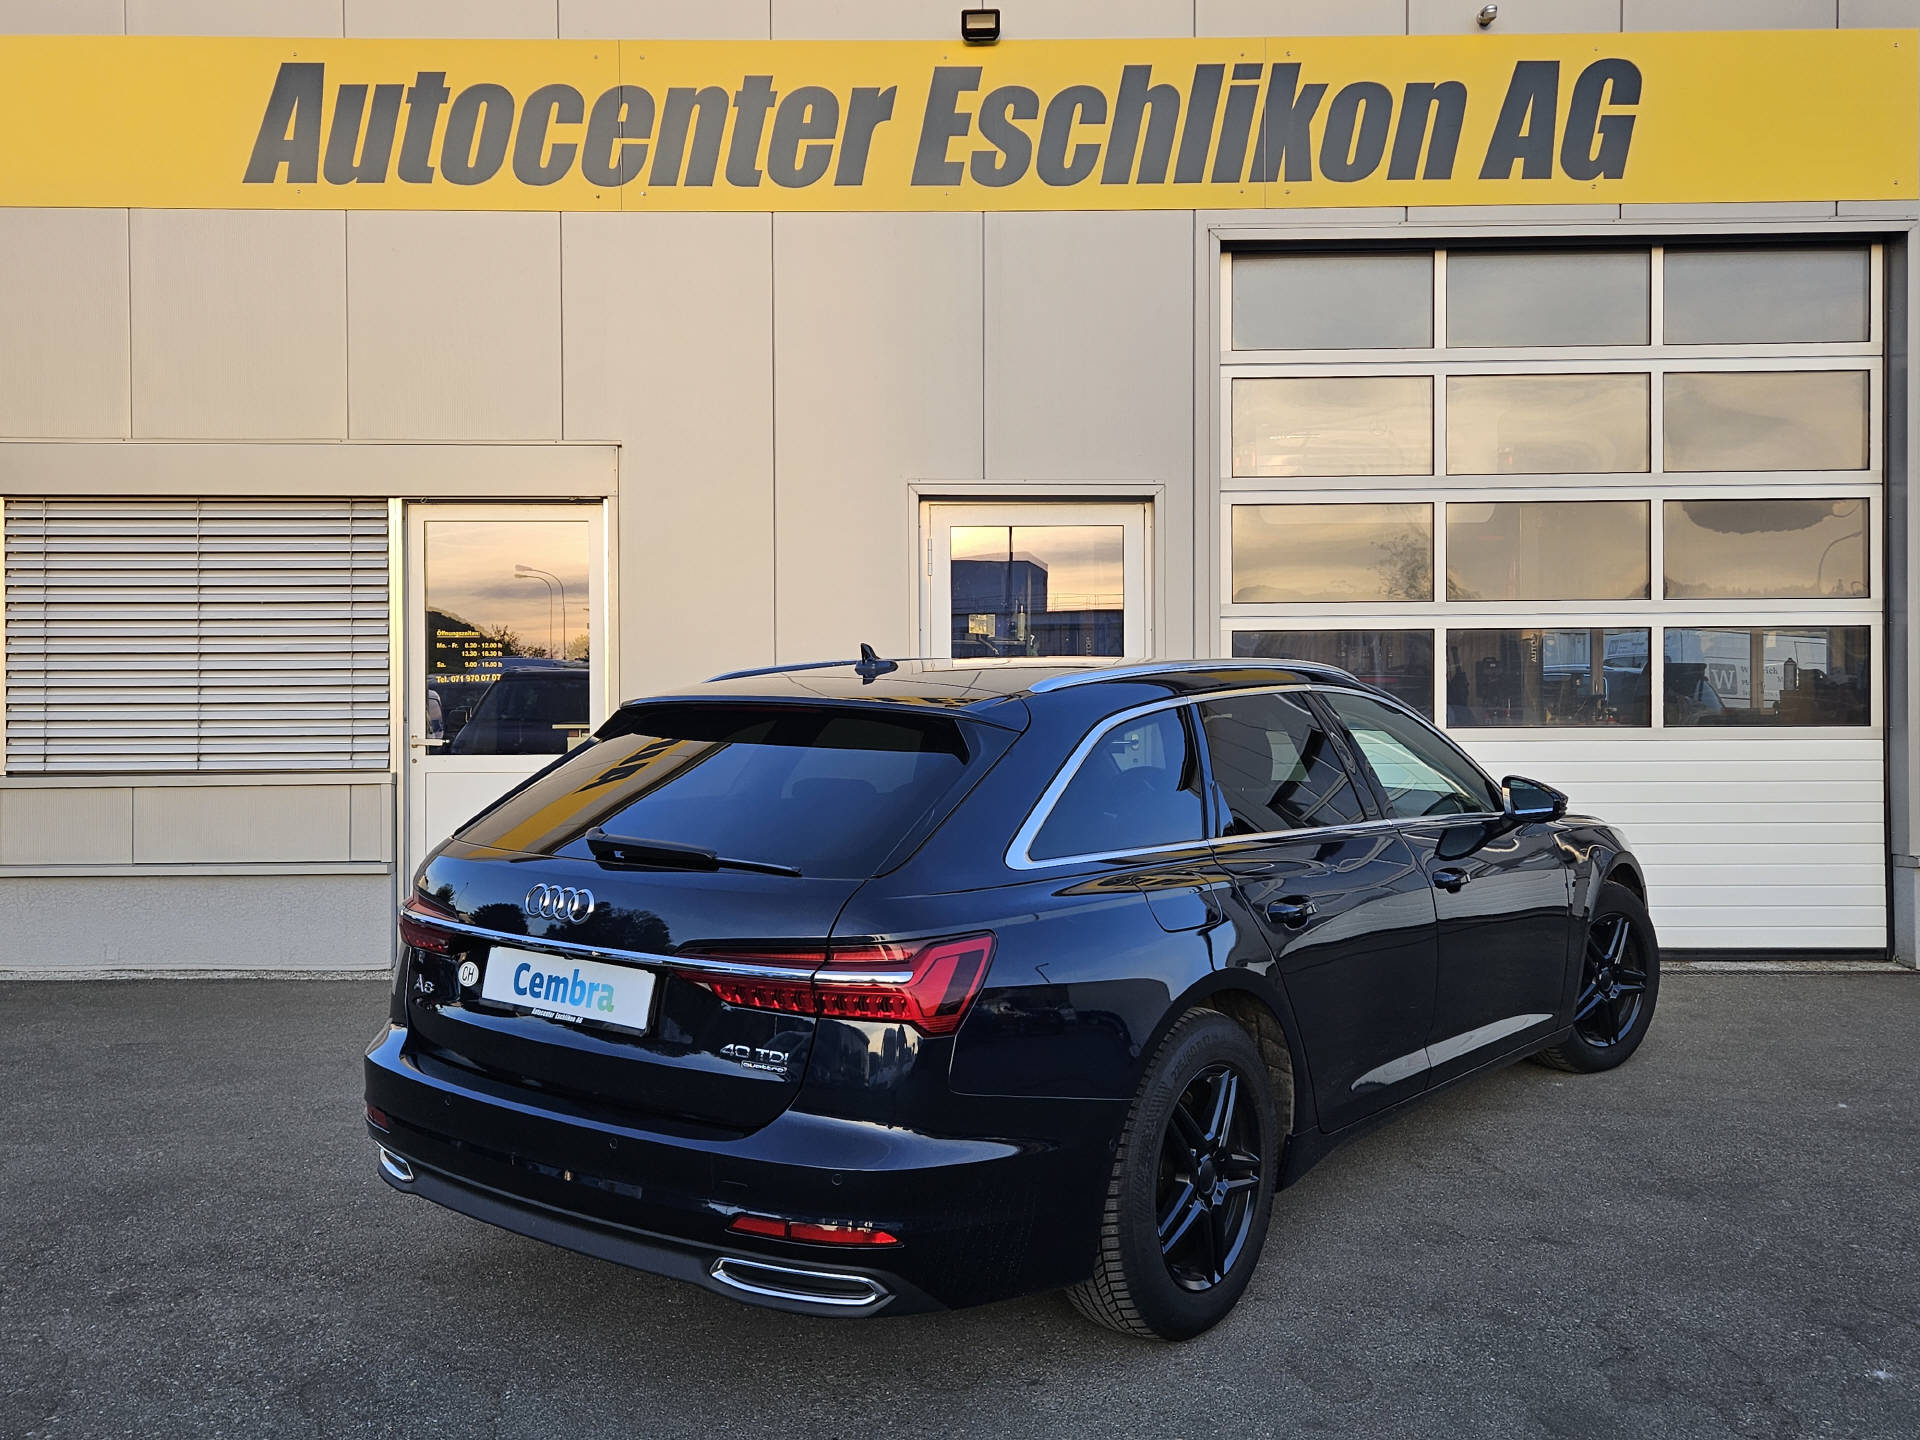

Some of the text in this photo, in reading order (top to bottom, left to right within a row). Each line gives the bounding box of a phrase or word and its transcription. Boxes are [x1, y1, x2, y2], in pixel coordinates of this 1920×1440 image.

[242, 58, 1643, 188] Autocenter Eschlikon AG
[436, 675, 450, 683] Tel.
[465, 674, 480, 682] 970
[461, 966, 474, 981] CH
[513, 962, 615, 1013] Cembra
[719, 1043, 790, 1066] 40 TDI
